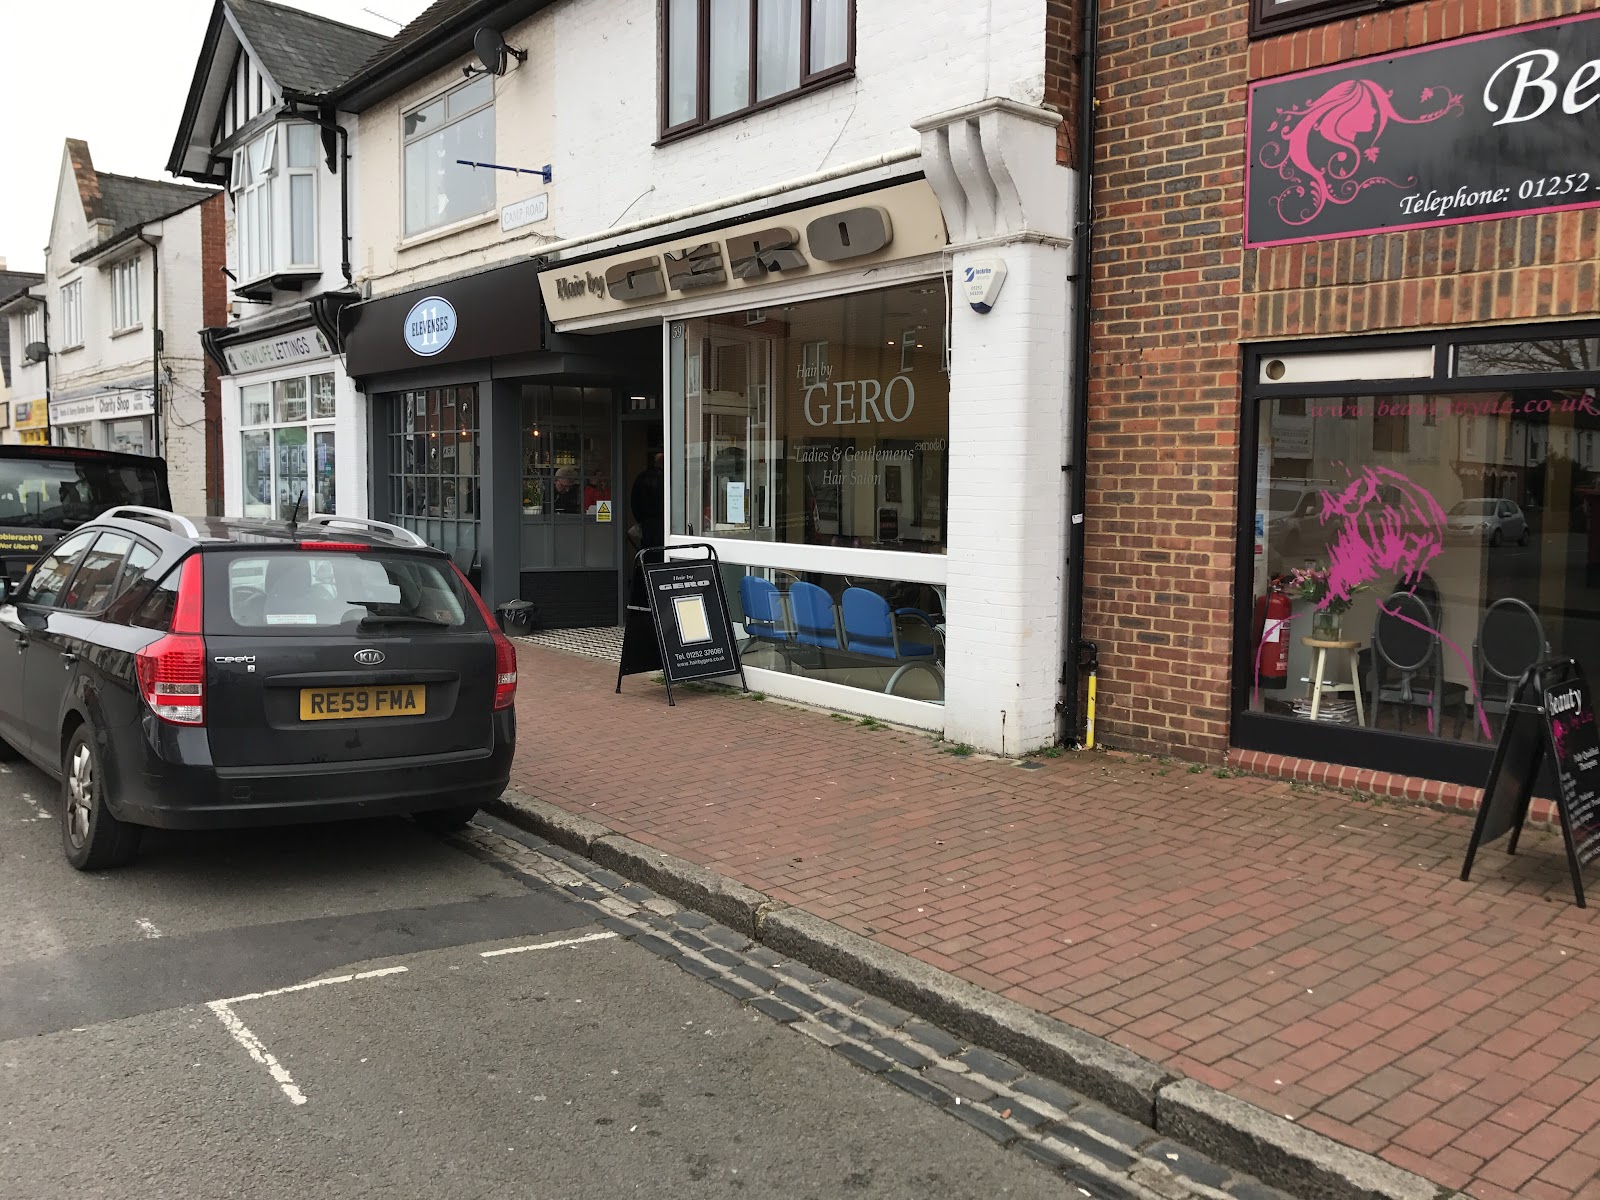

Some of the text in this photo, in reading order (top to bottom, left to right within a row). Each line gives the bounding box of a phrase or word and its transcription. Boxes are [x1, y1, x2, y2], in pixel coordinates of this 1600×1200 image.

[1399, 172, 1590, 217] Telephone: 01252
[504, 201, 545, 225] CAMP ROAD
[555, 205, 893, 301] Hair by GERO
[411, 316, 449, 337] ELEVENSES
[672, 325, 682, 339] 59
[272, 336, 311, 360] LETTINGS
[796, 362, 833, 380] Hair by
[99, 398, 116, 415] Charity
[117, 396, 130, 413] Shop
[803, 376, 915, 427] GERO
[796, 446, 829, 463] Ladies
[831, 447, 843, 462] &
[844, 445, 914, 462] Gentlemens
[822, 469, 881, 485] Hair Salon
[658, 580, 710, 591] GERO
[359, 652, 380, 662] KIA
[686, 650, 704, 659] 01252
[311, 689, 416, 714] RE59 FMA
